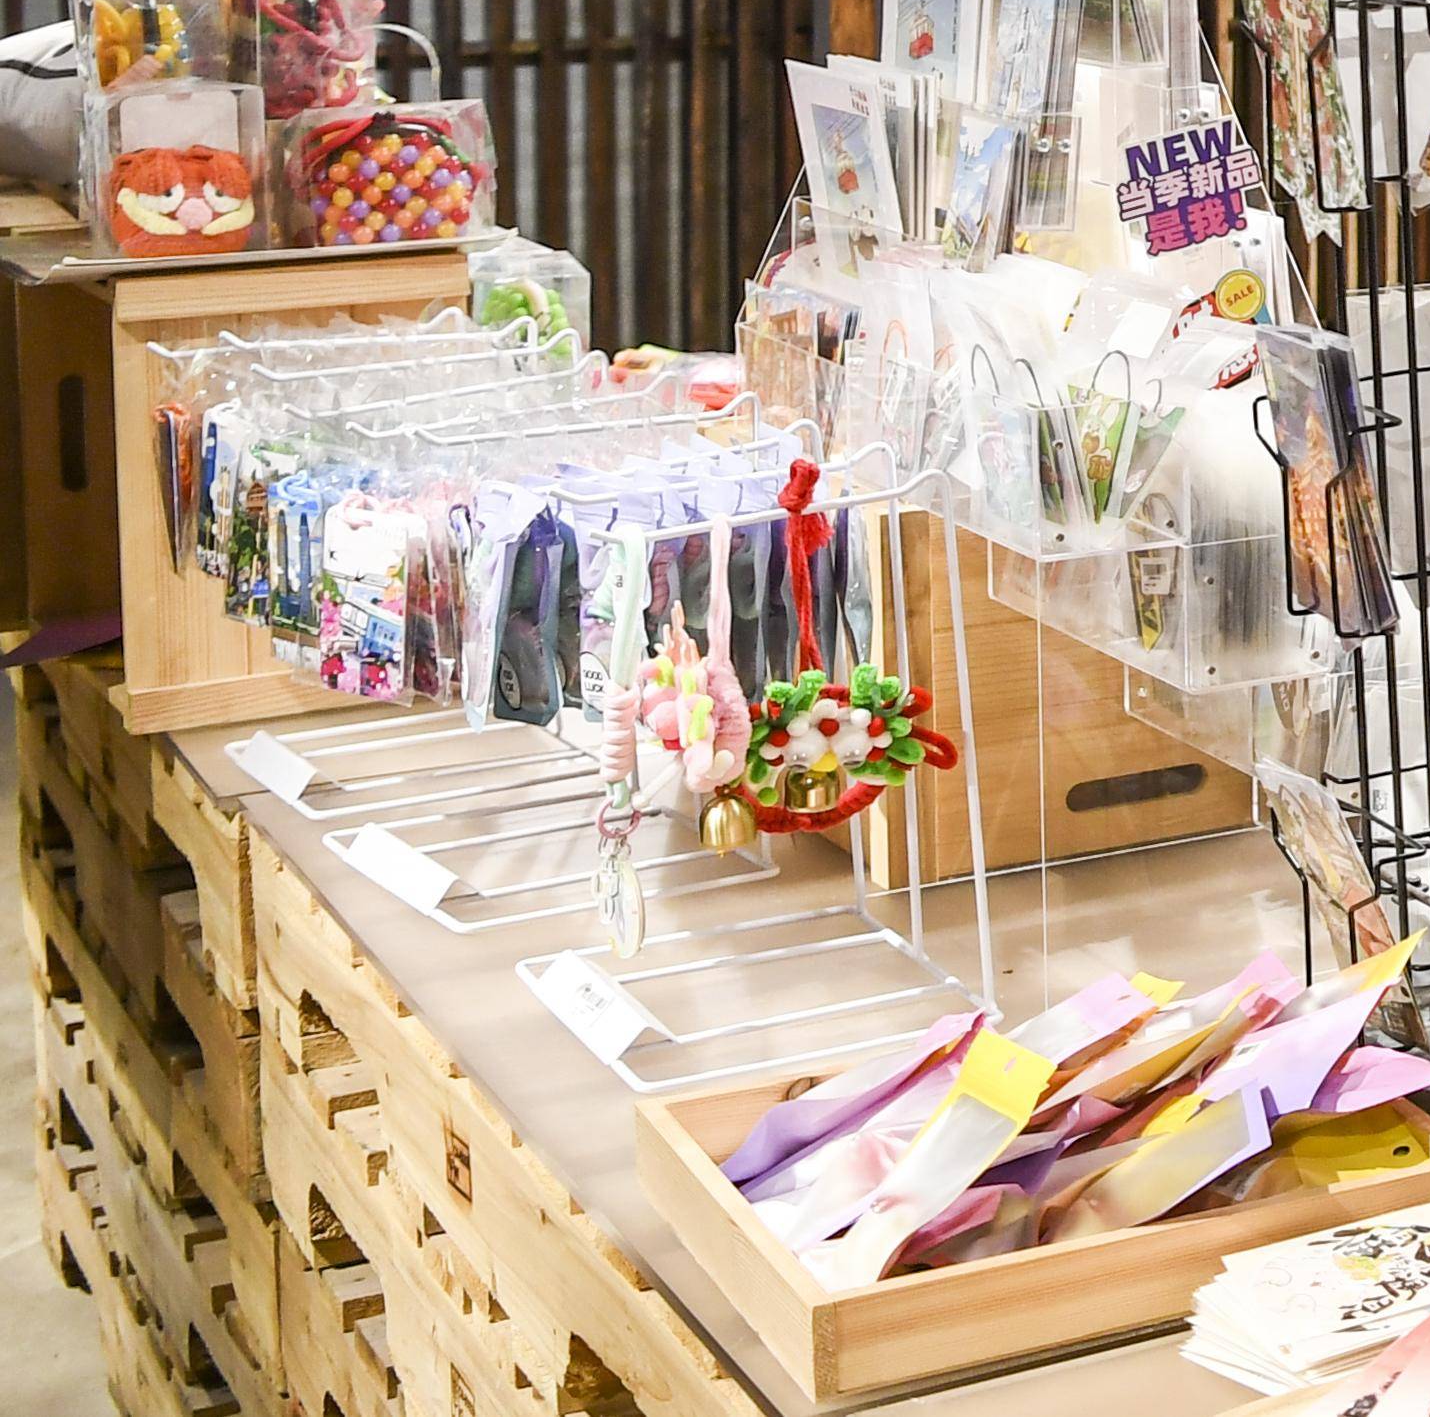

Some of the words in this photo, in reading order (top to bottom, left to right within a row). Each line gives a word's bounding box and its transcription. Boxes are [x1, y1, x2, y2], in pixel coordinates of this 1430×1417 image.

[1126, 120, 1233, 180] NEW
[1117, 149, 1260, 220] 当季新品
[1225, 284, 1255, 307] SALE
